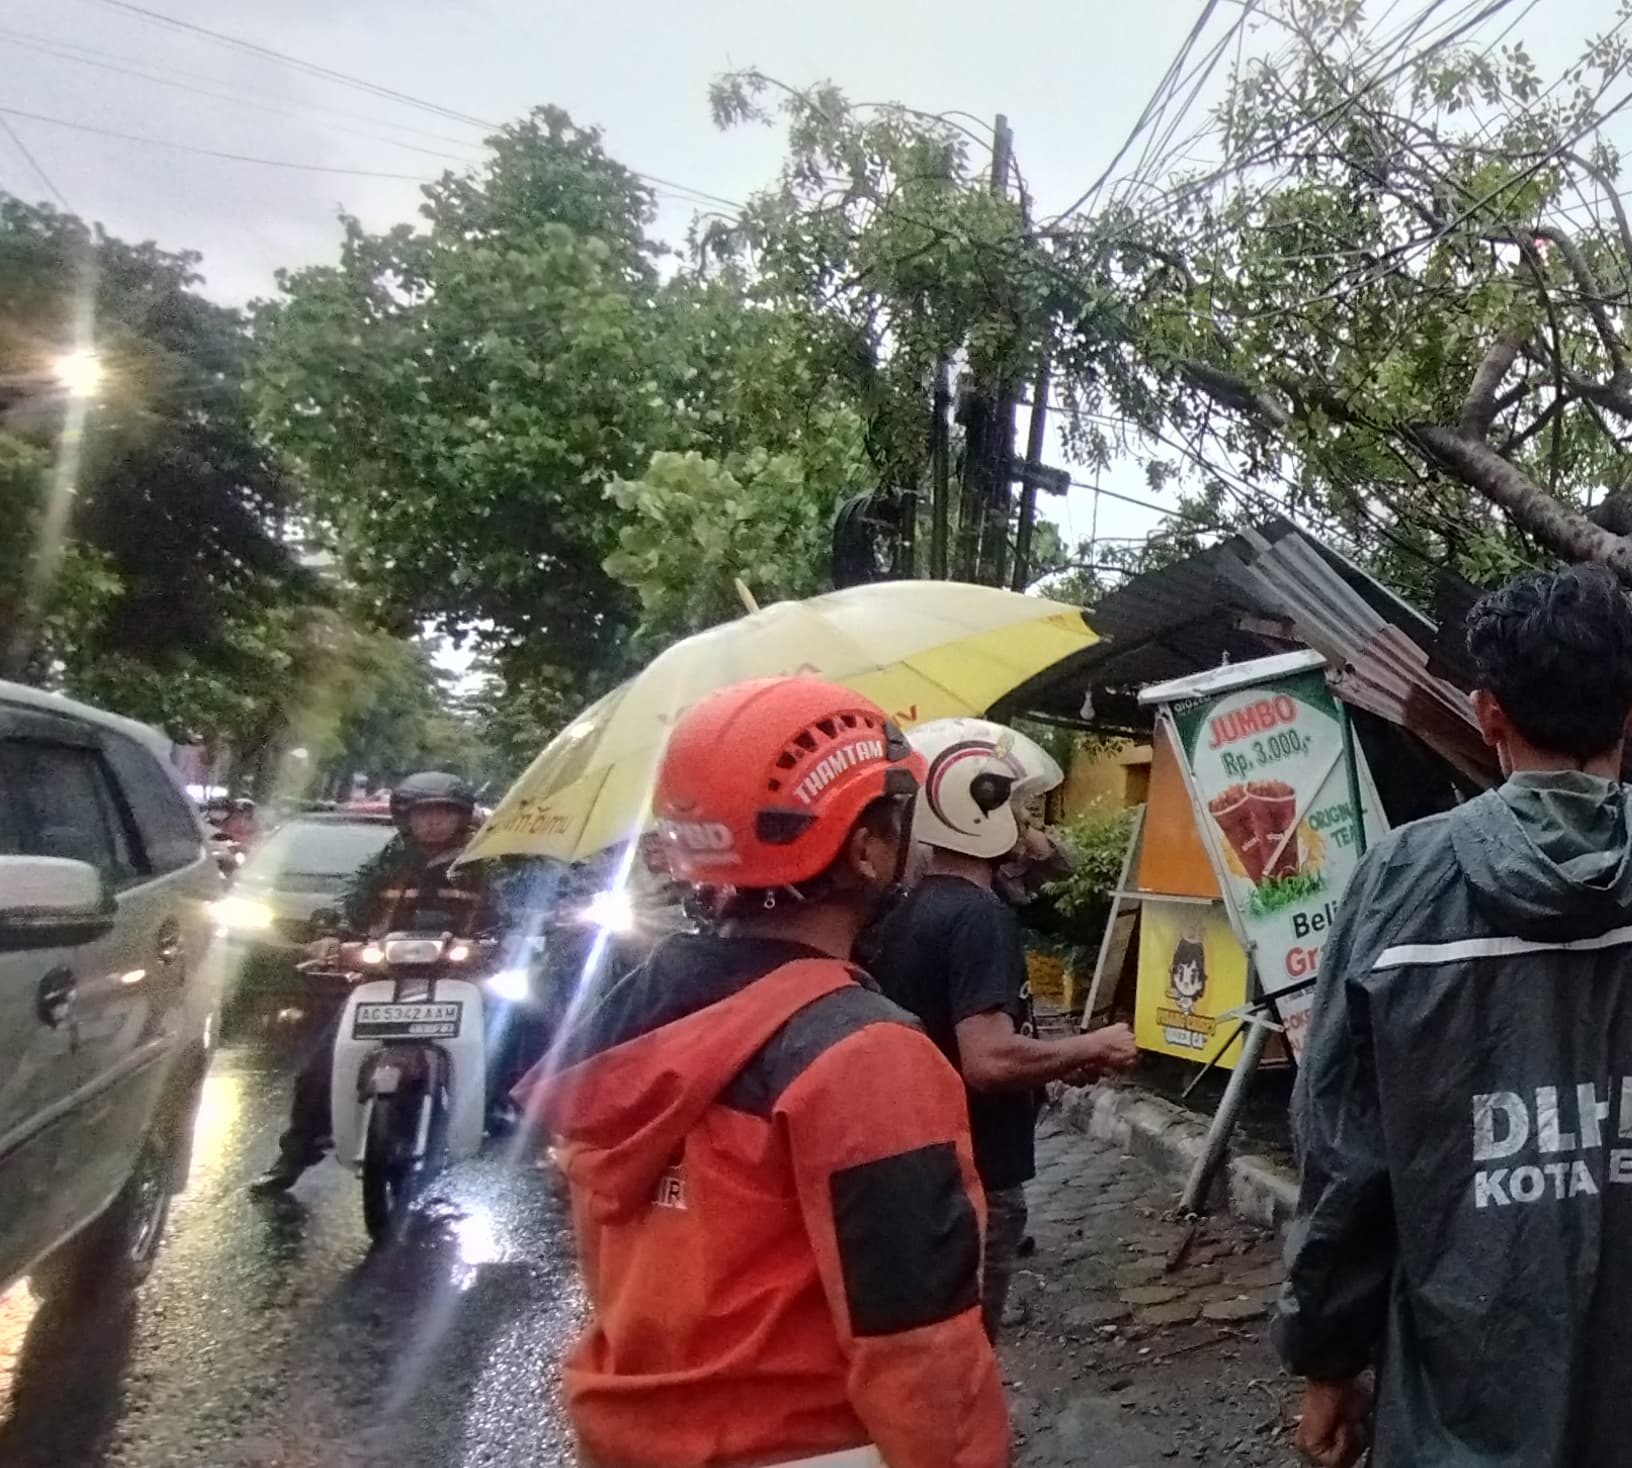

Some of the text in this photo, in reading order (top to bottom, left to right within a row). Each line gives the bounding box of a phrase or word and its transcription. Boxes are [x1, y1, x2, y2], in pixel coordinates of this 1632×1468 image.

[1209, 693, 1298, 749] JUMBO
[1222, 752, 1253, 777] Rp.
[1286, 946, 1319, 977] Gr
[1474, 1160, 1600, 1208] KOTA
